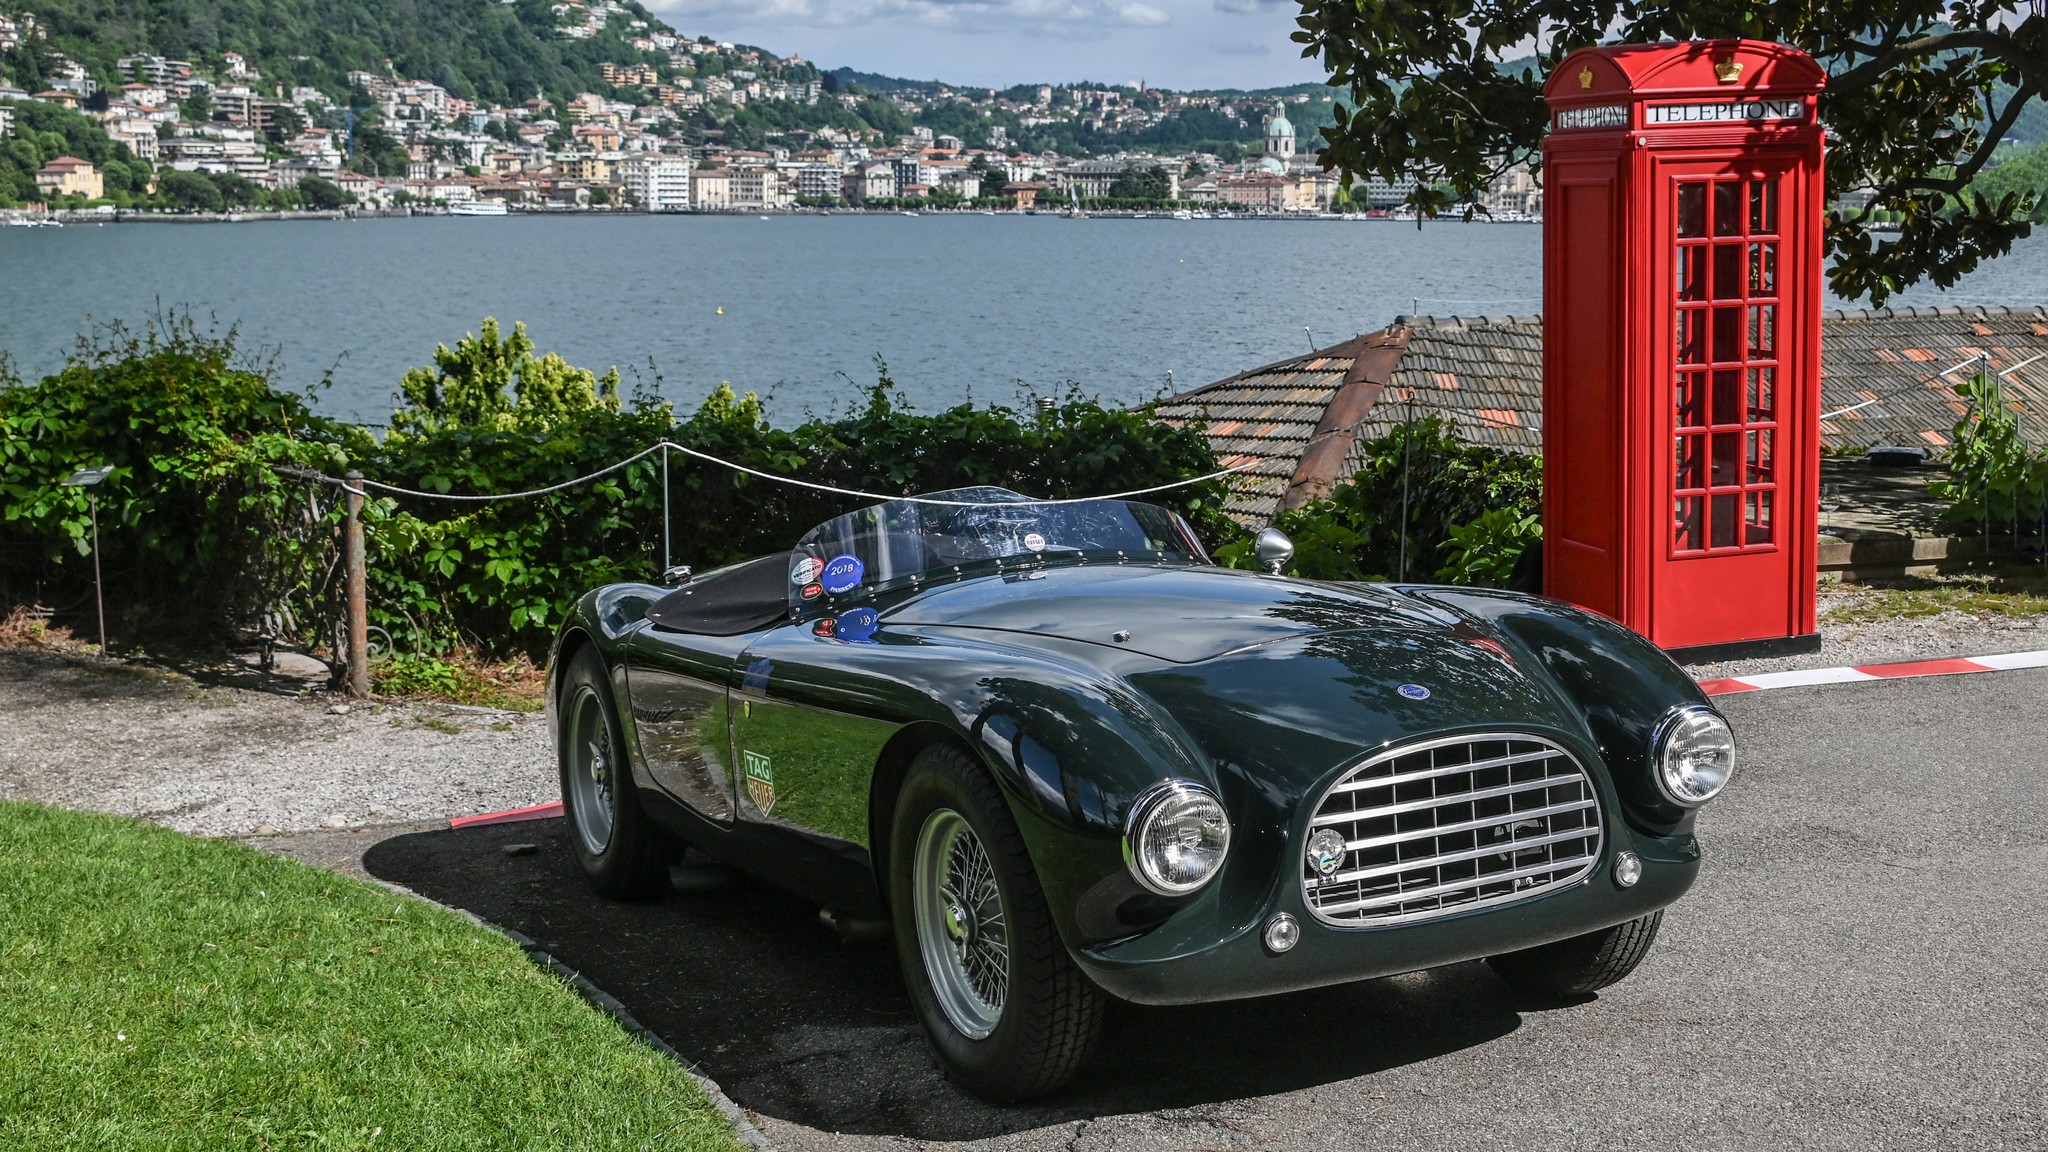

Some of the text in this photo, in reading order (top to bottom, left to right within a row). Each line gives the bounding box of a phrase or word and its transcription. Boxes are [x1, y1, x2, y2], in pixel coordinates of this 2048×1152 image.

[1651, 100, 1800, 122] TELEPHONE
[830, 563, 854, 576] 2018
[829, 582, 855, 593] PASSED
[746, 755, 770, 780] TAG
[748, 780, 774, 812] HEUER
